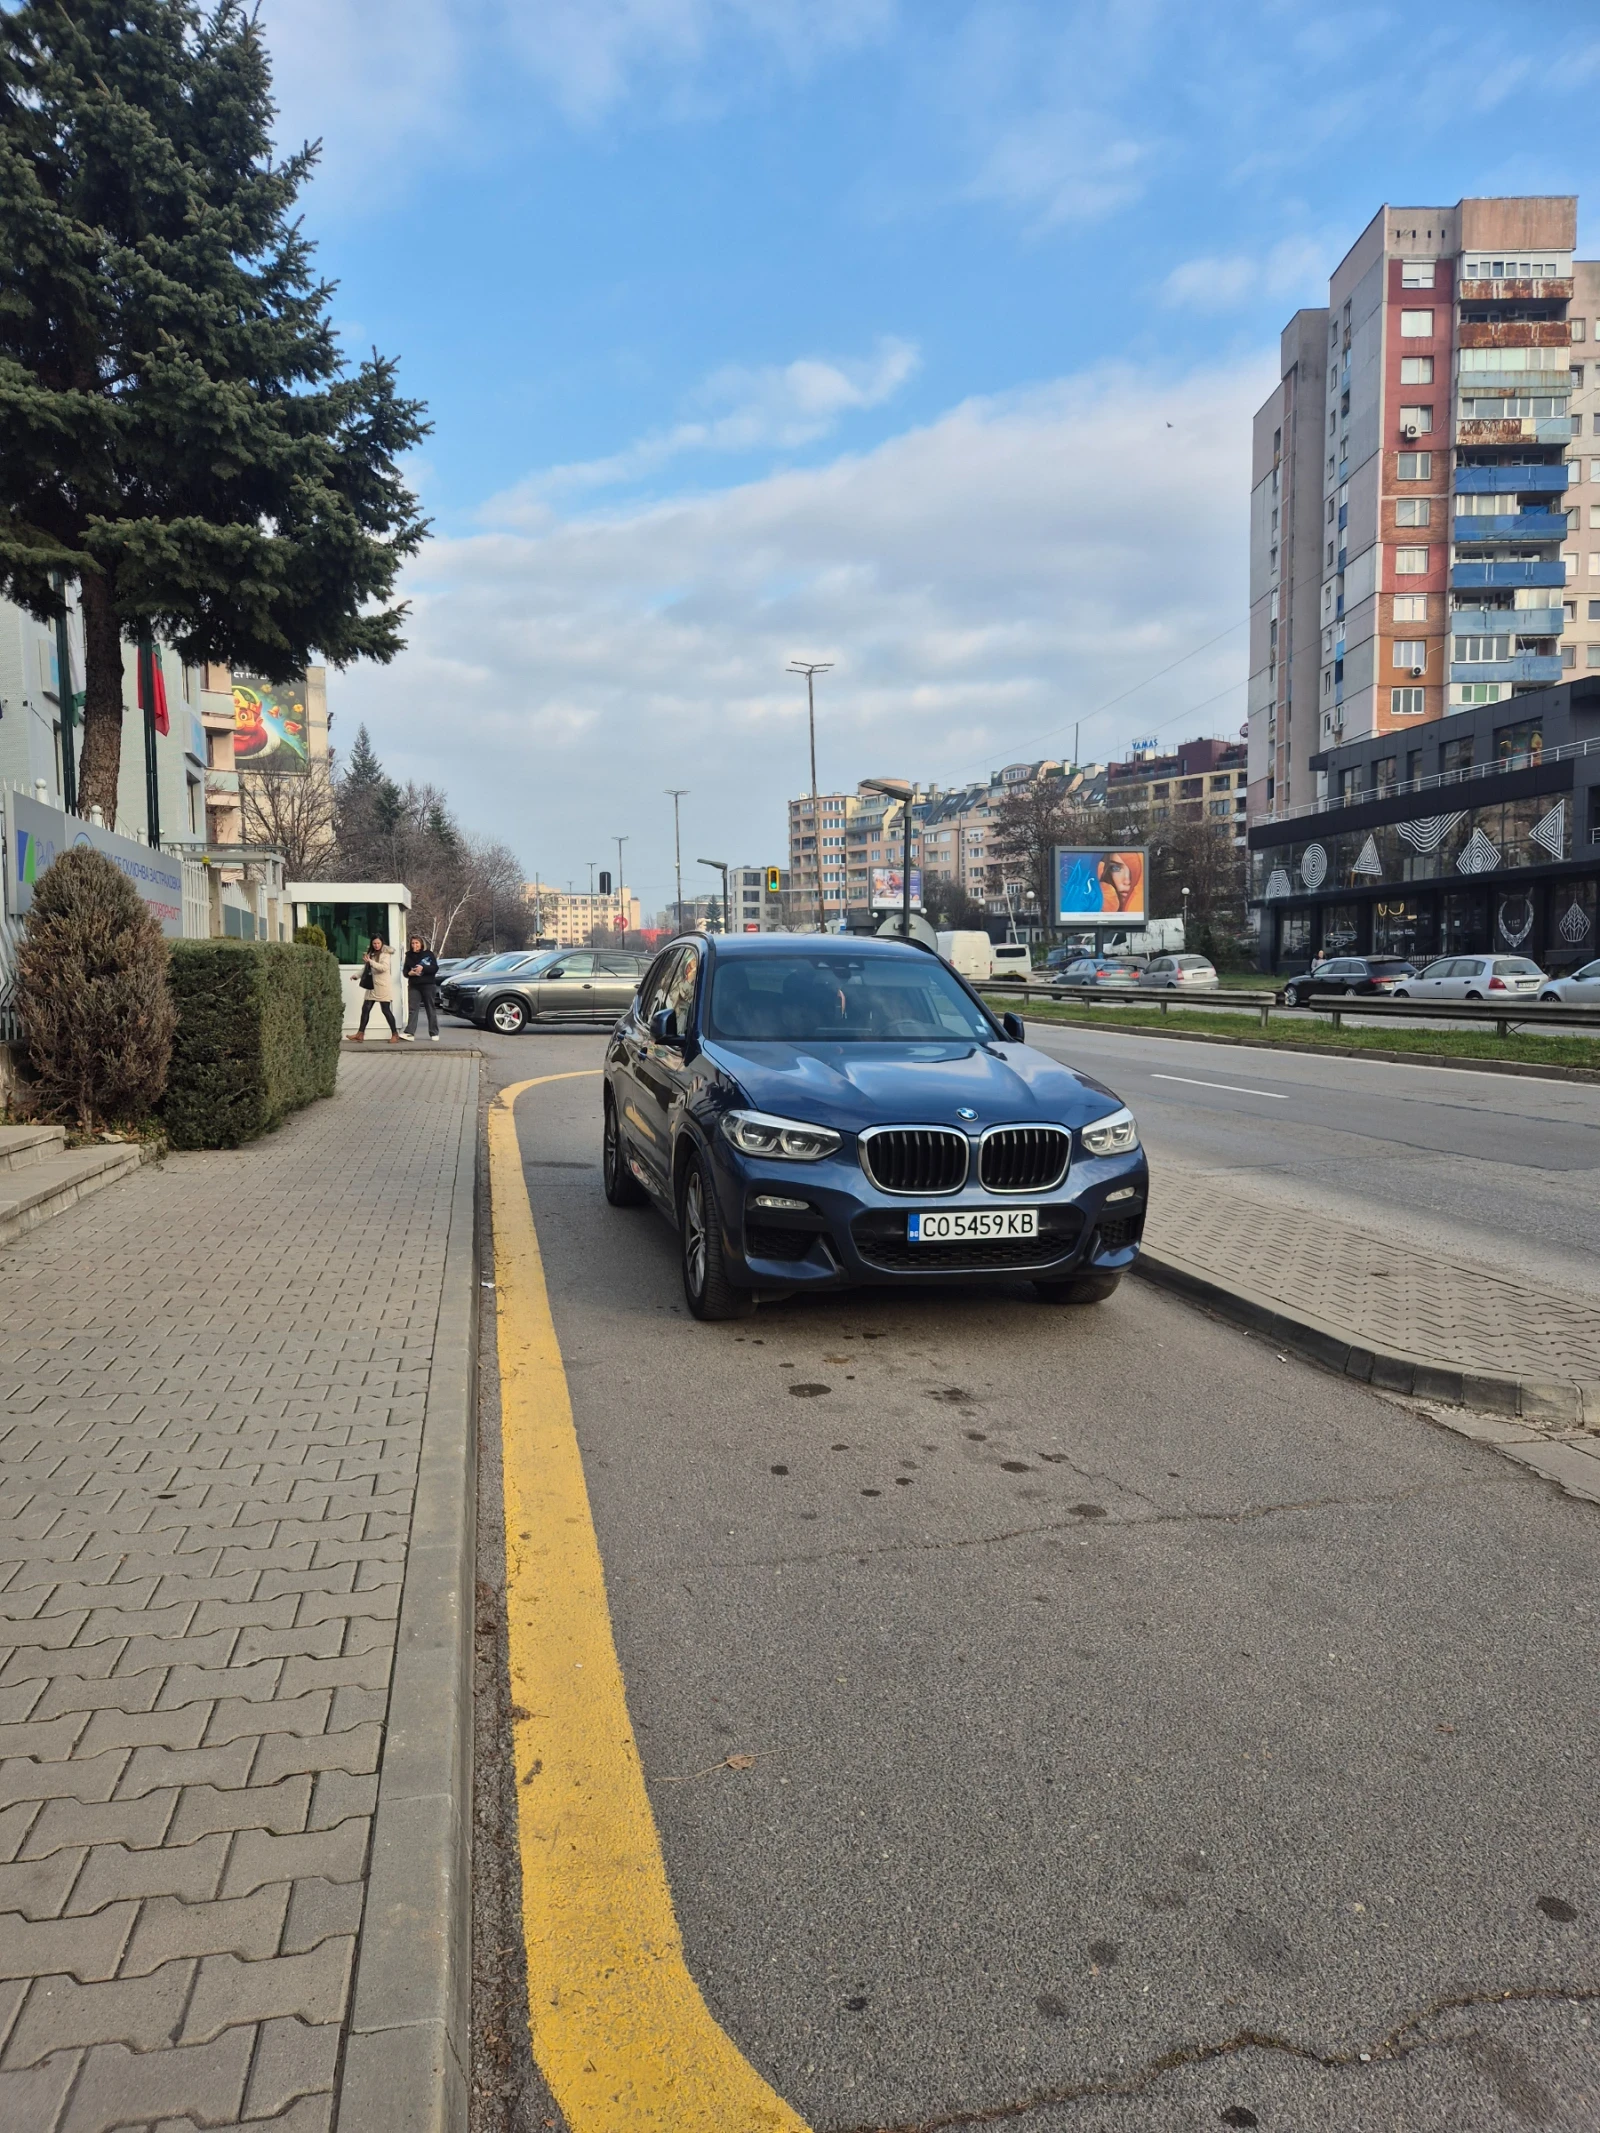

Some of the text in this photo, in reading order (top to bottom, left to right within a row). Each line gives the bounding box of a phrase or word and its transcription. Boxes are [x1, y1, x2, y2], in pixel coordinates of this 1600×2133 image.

[1131, 738, 1159, 750] YAMAS
[123, 858, 149, 881] СКЛЮЧВА
[149, 867, 181, 890] ЗАСТРАХОВКА
[954, 1214, 1004, 1236] 5459
[1008, 1213, 1033, 1235] KB
